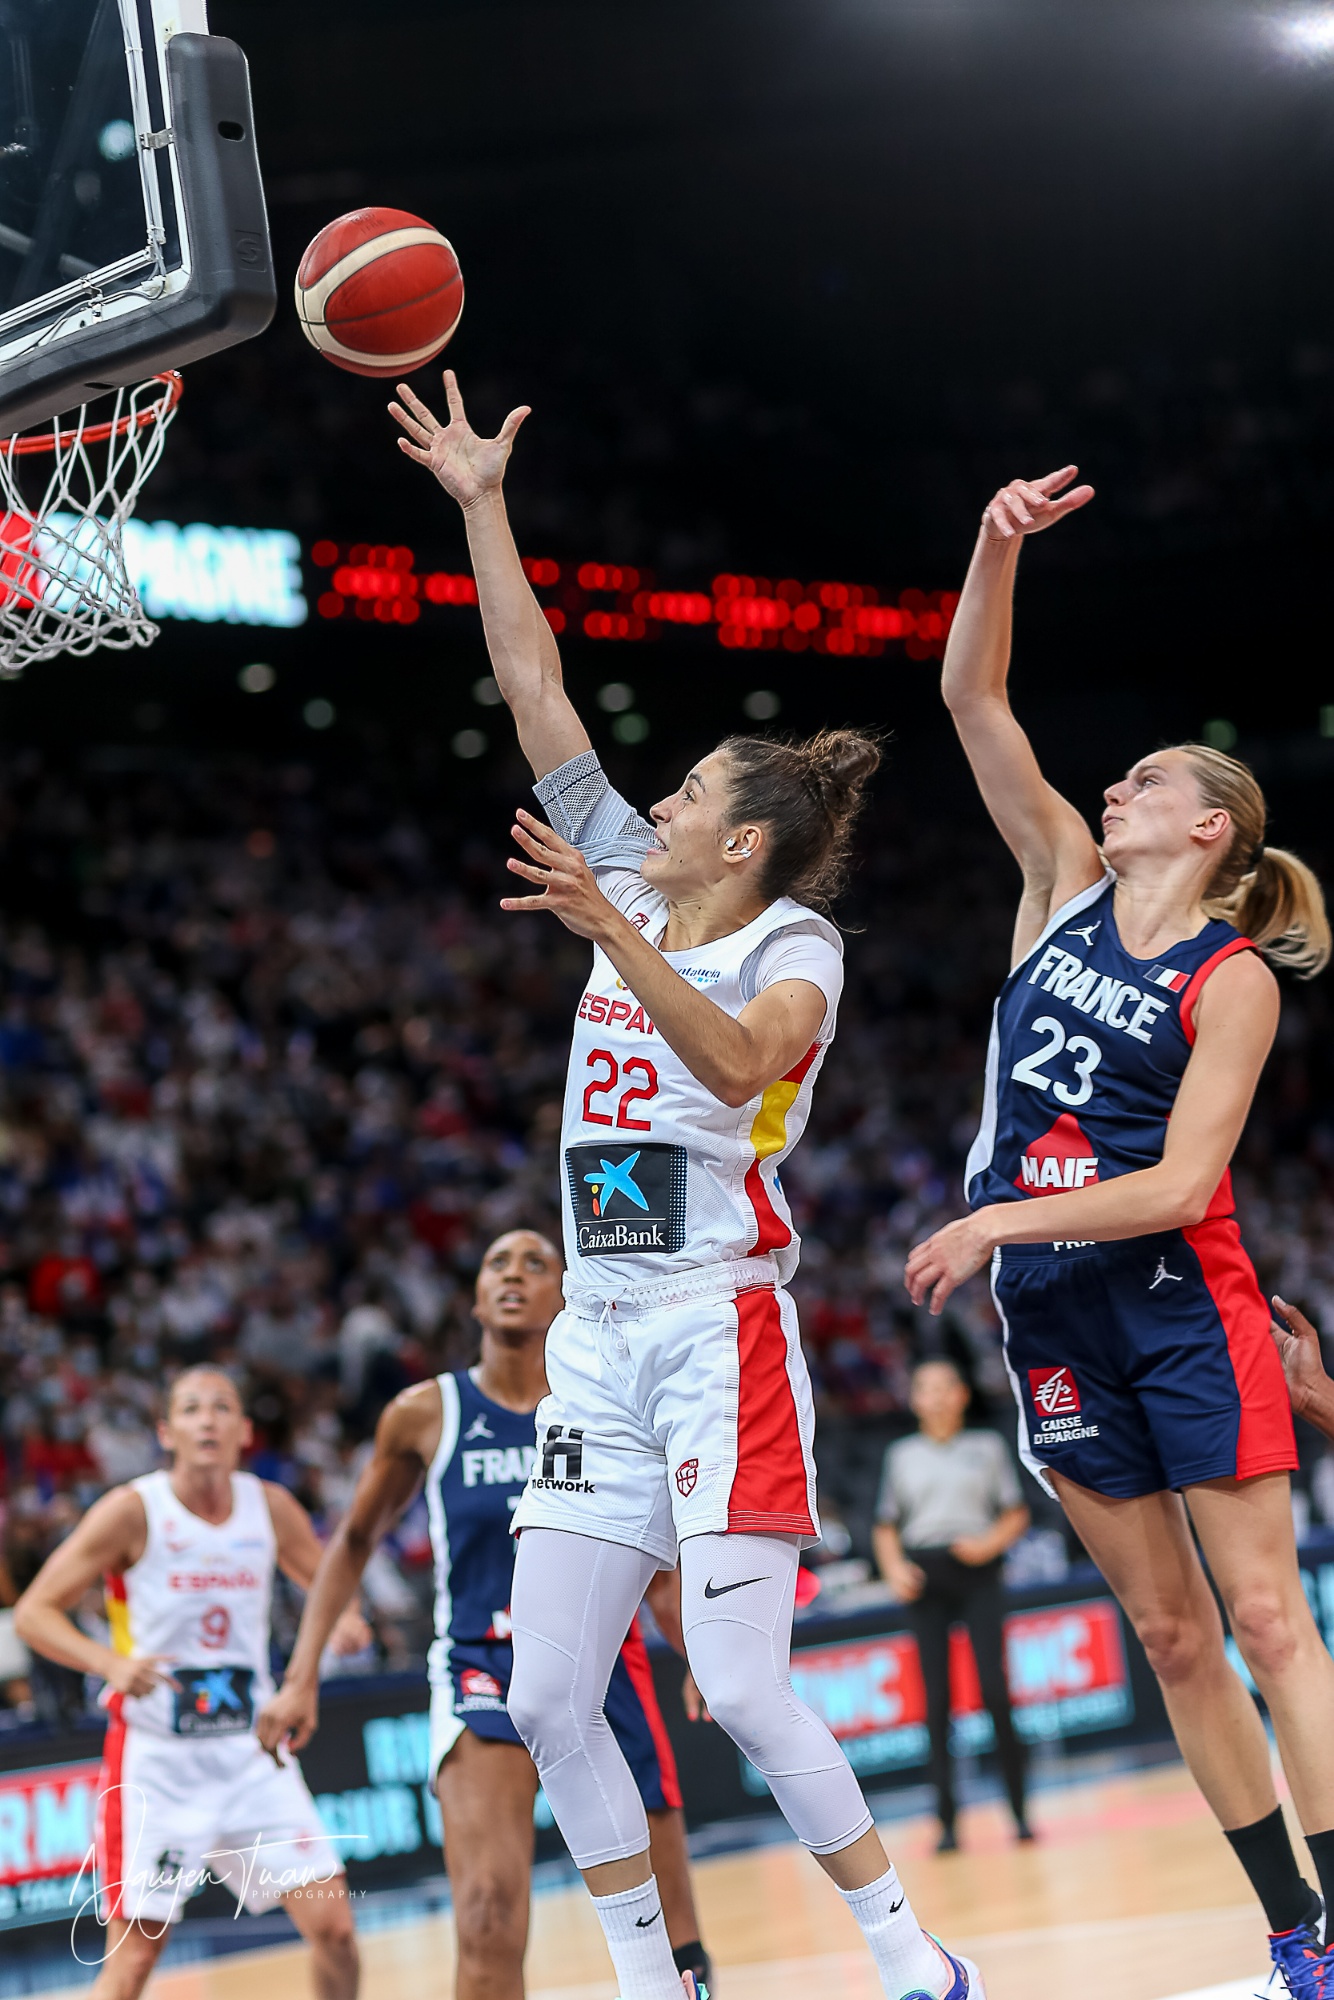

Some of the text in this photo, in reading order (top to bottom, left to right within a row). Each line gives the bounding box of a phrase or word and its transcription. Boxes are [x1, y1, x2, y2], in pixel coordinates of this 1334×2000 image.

[1027, 944, 1170, 1044] FRANCE
[1011, 1015, 1102, 1106] 23
[582, 1048, 659, 1131] 22
[1020, 1155, 1099, 1188] MAIF
[579, 1223, 666, 1249] CaixaBank
[1040, 1415, 1083, 1432] CAISSE
[531, 1477, 596, 1494] network
[200, 1603, 230, 1650] 9
